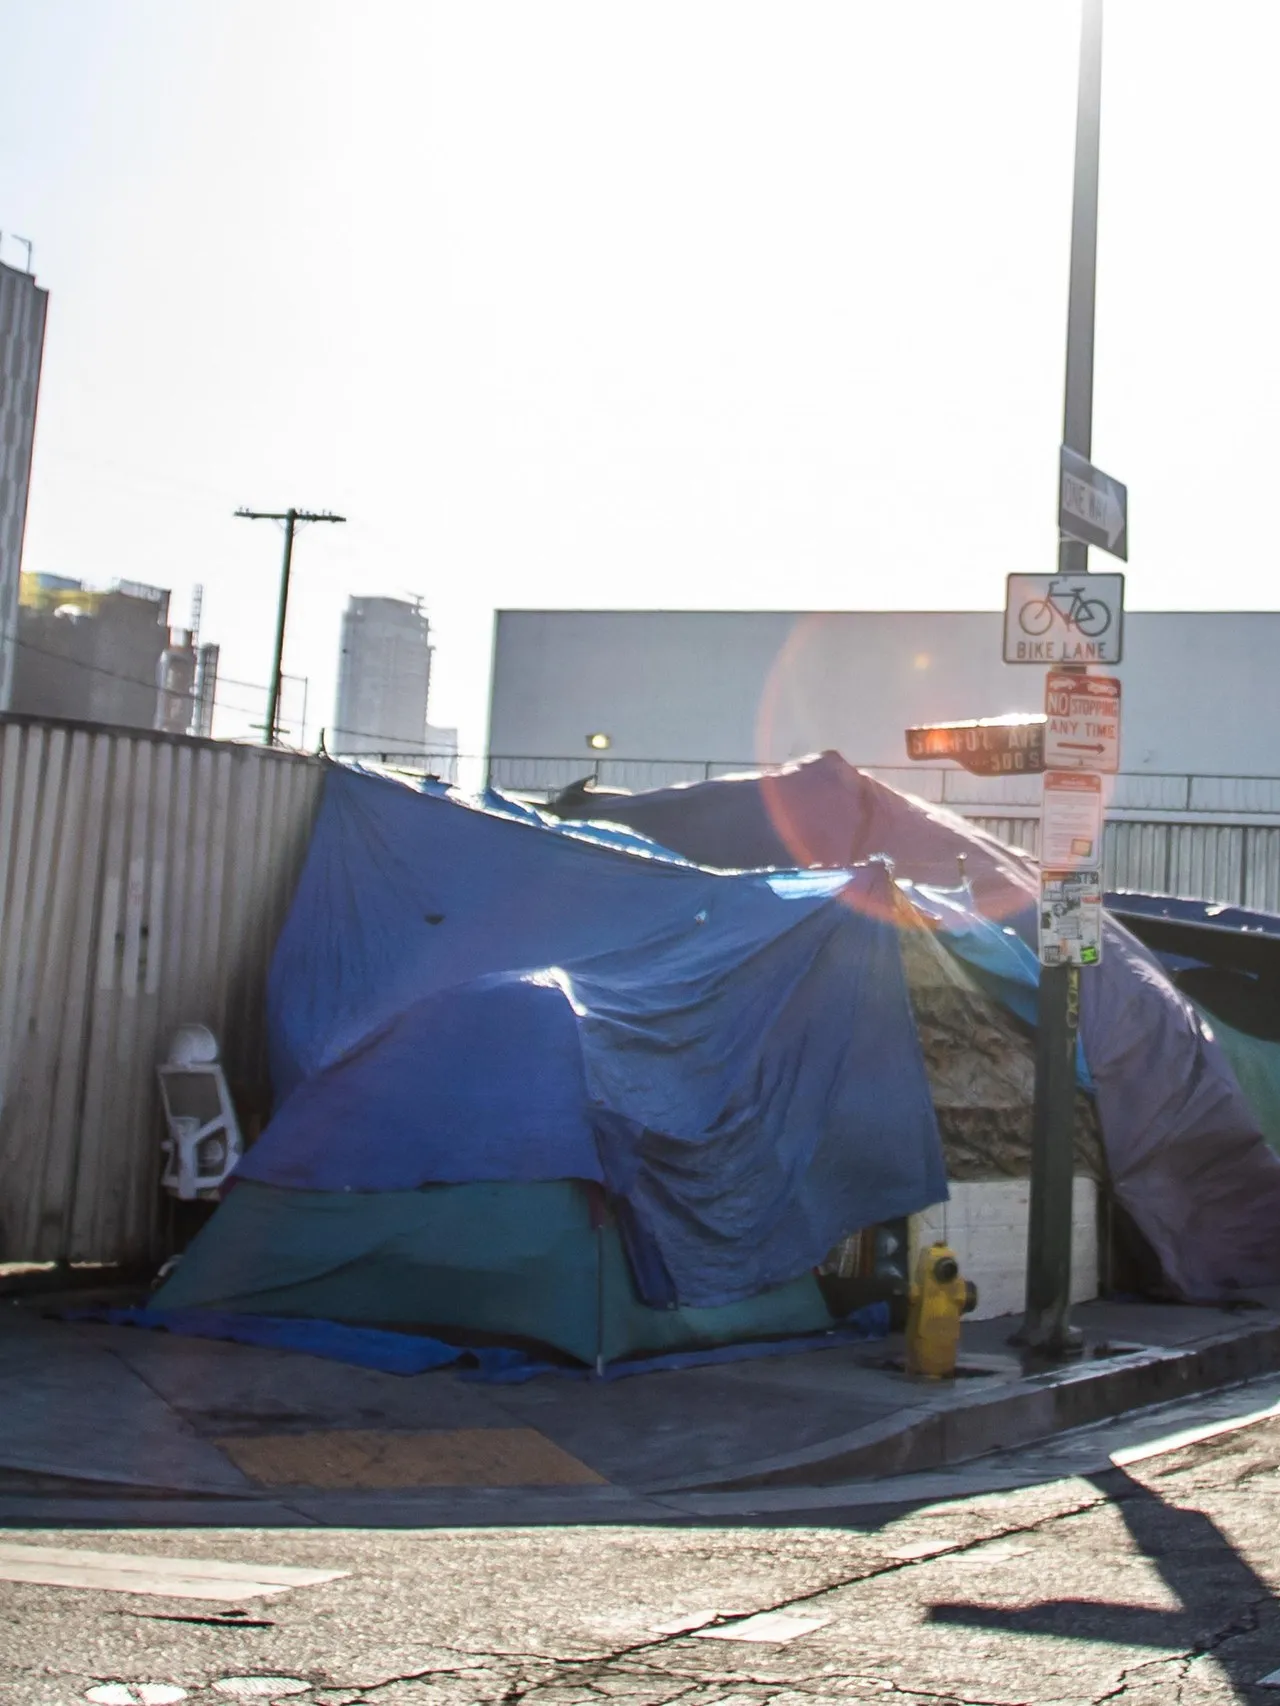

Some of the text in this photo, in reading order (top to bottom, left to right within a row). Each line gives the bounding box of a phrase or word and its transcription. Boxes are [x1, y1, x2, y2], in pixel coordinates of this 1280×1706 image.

[1016, 641, 1107, 660] BIKE LANE
[1047, 691, 1118, 717] NO STOPPING
[1050, 719, 1117, 739] ANY TIME
